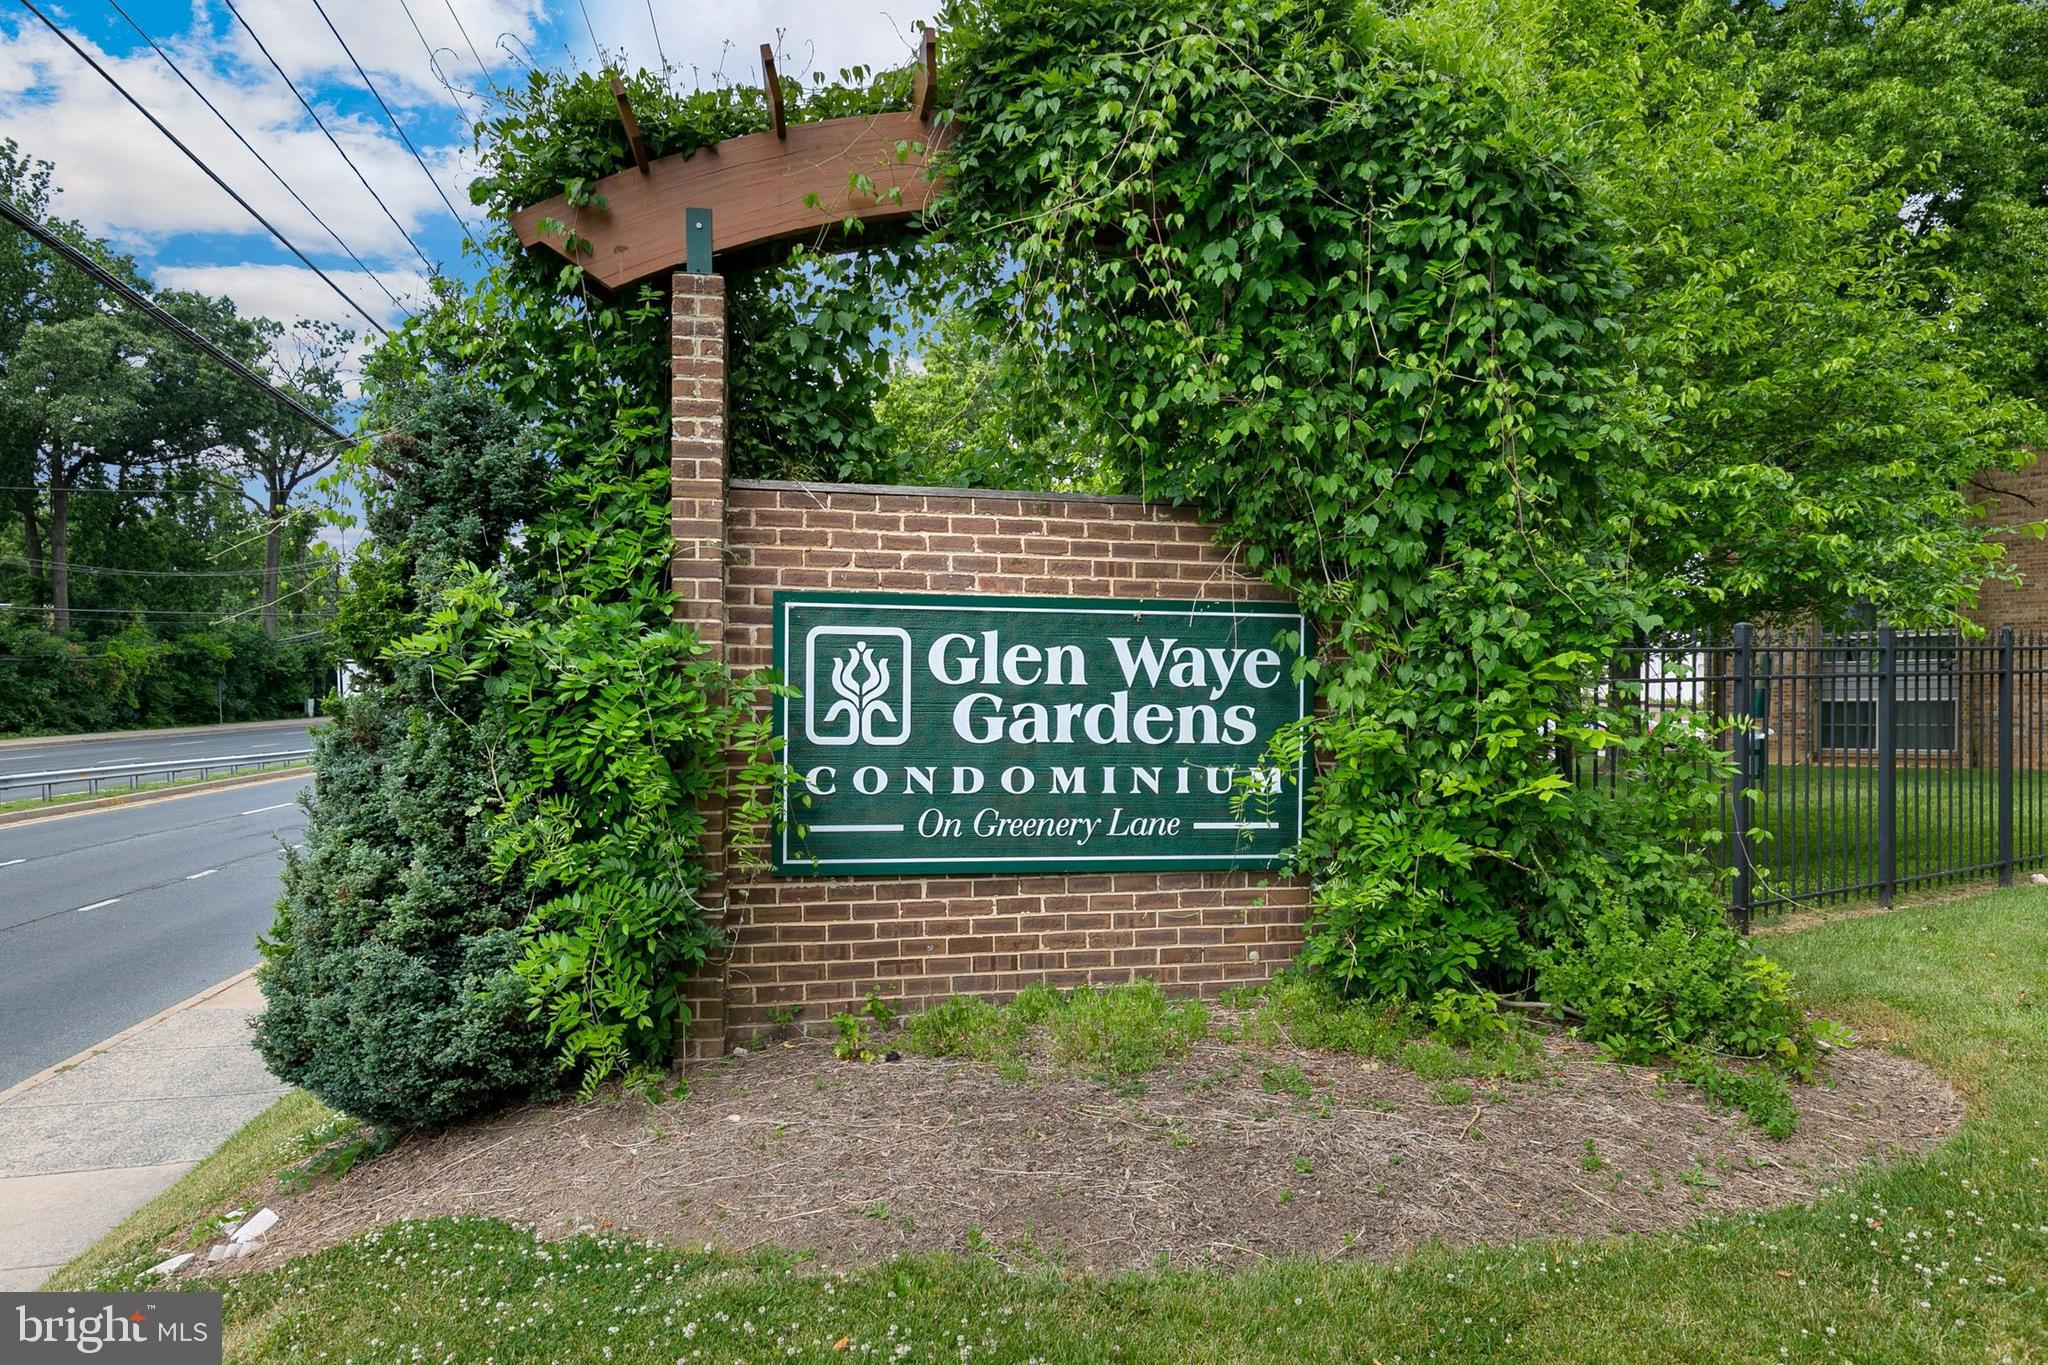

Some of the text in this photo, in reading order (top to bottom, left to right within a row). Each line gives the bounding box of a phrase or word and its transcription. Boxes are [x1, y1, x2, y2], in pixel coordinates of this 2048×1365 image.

[928, 630, 1281, 700] Glen Waye
[952, 692, 1257, 745] Gardens
[805, 765, 1283, 796] CONDOMINIUM
[917, 808, 1181, 845] On Greenery Lane
